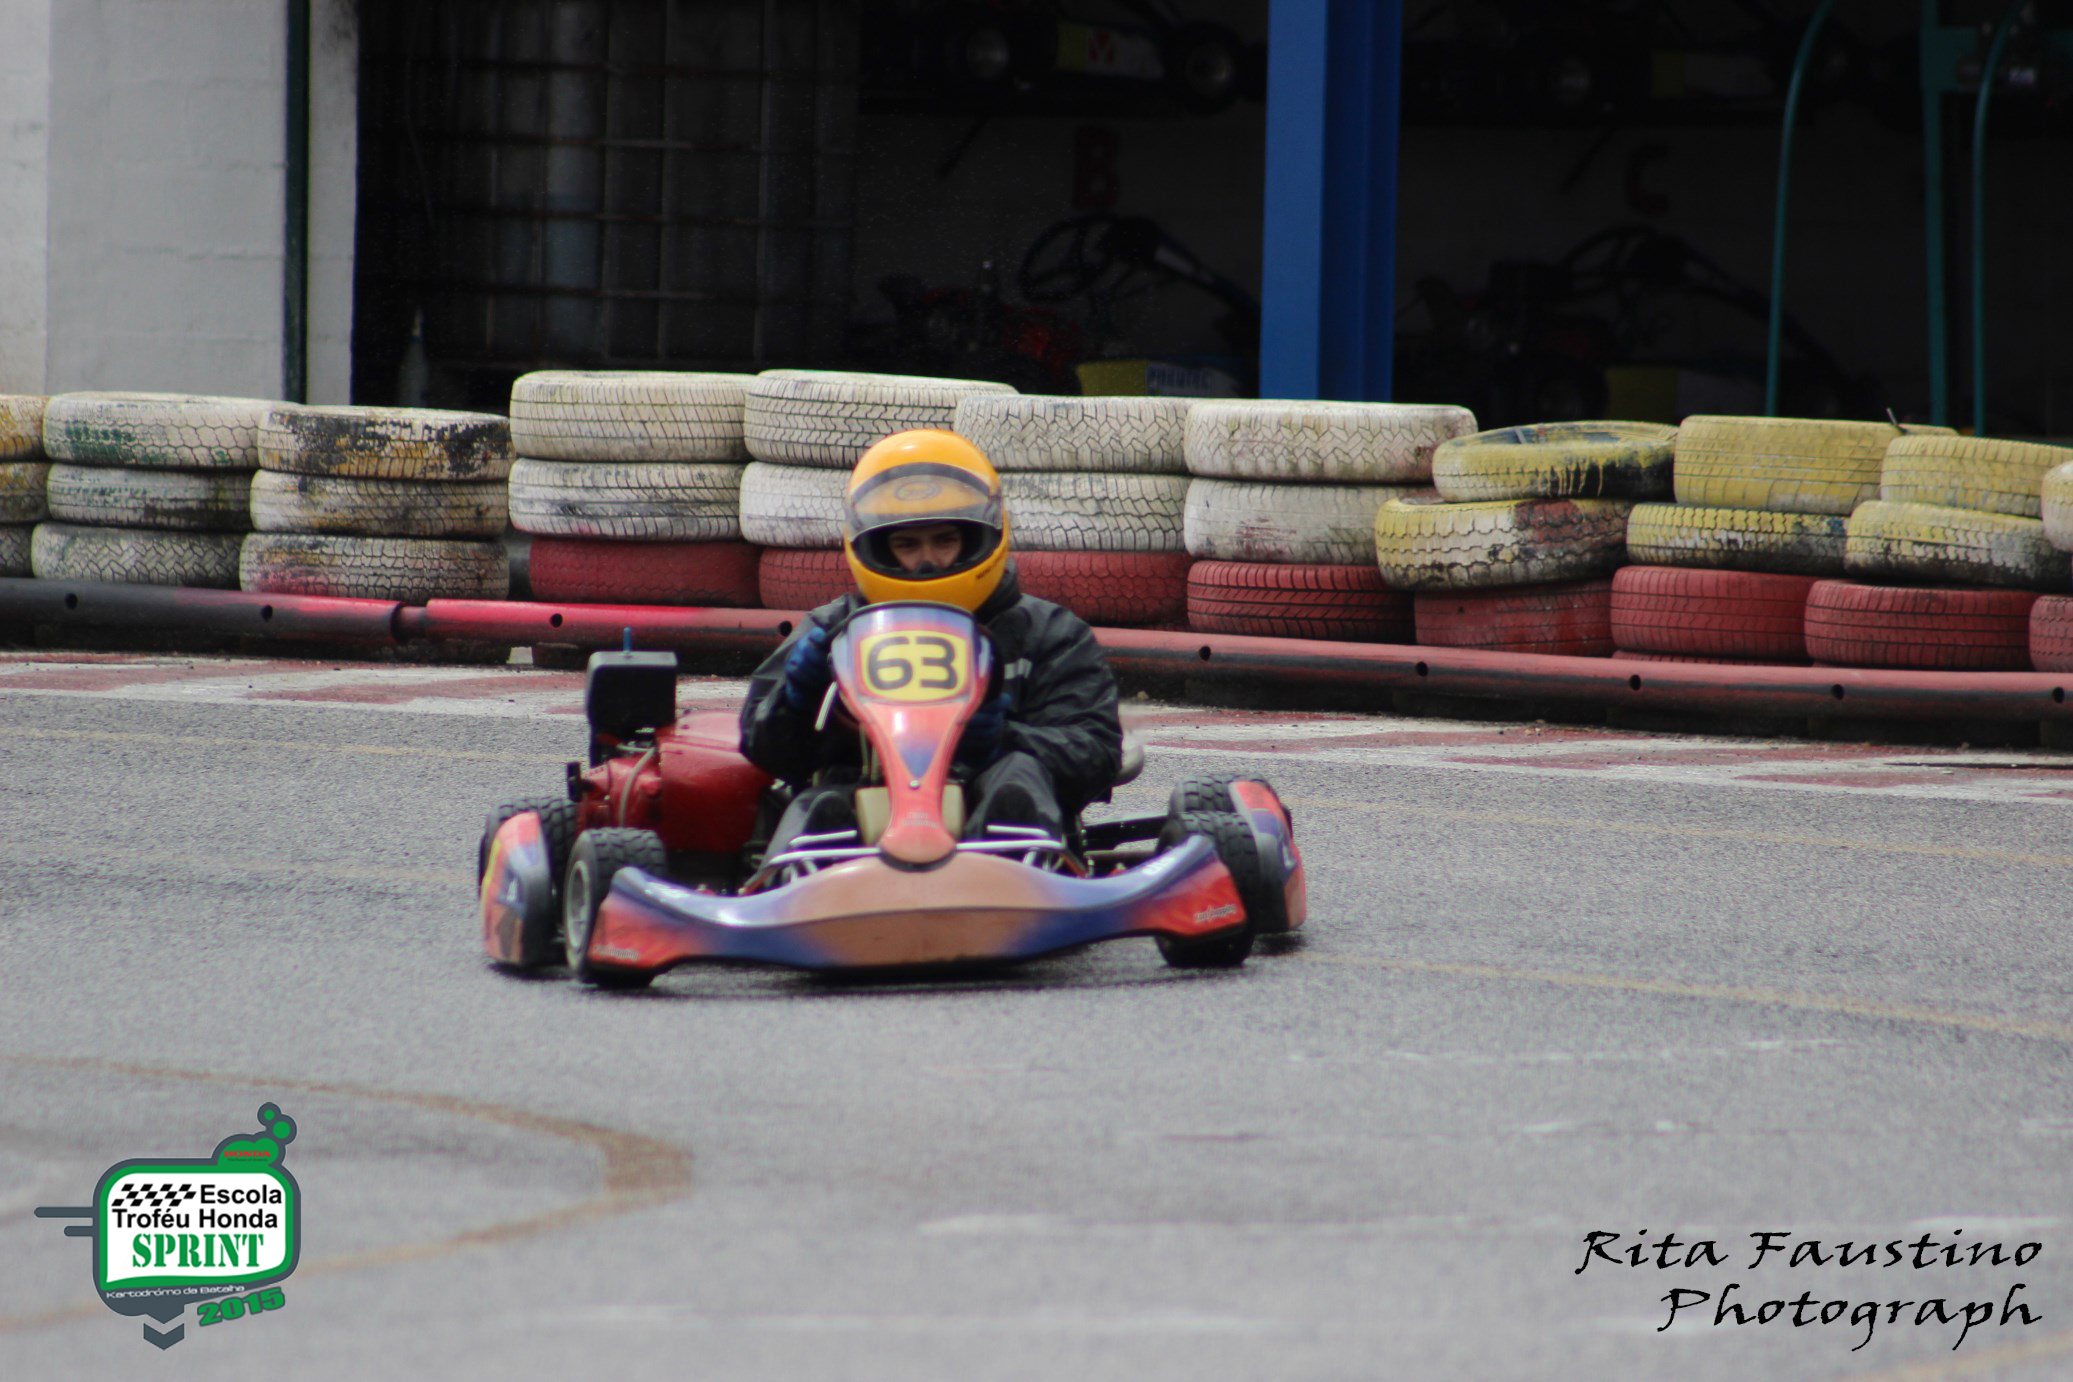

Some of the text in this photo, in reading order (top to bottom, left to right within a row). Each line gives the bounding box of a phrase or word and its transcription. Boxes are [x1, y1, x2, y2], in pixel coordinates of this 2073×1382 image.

[1075, 126, 1117, 209] B
[1629, 142, 1668, 218] C
[867, 635, 958, 690] 63
